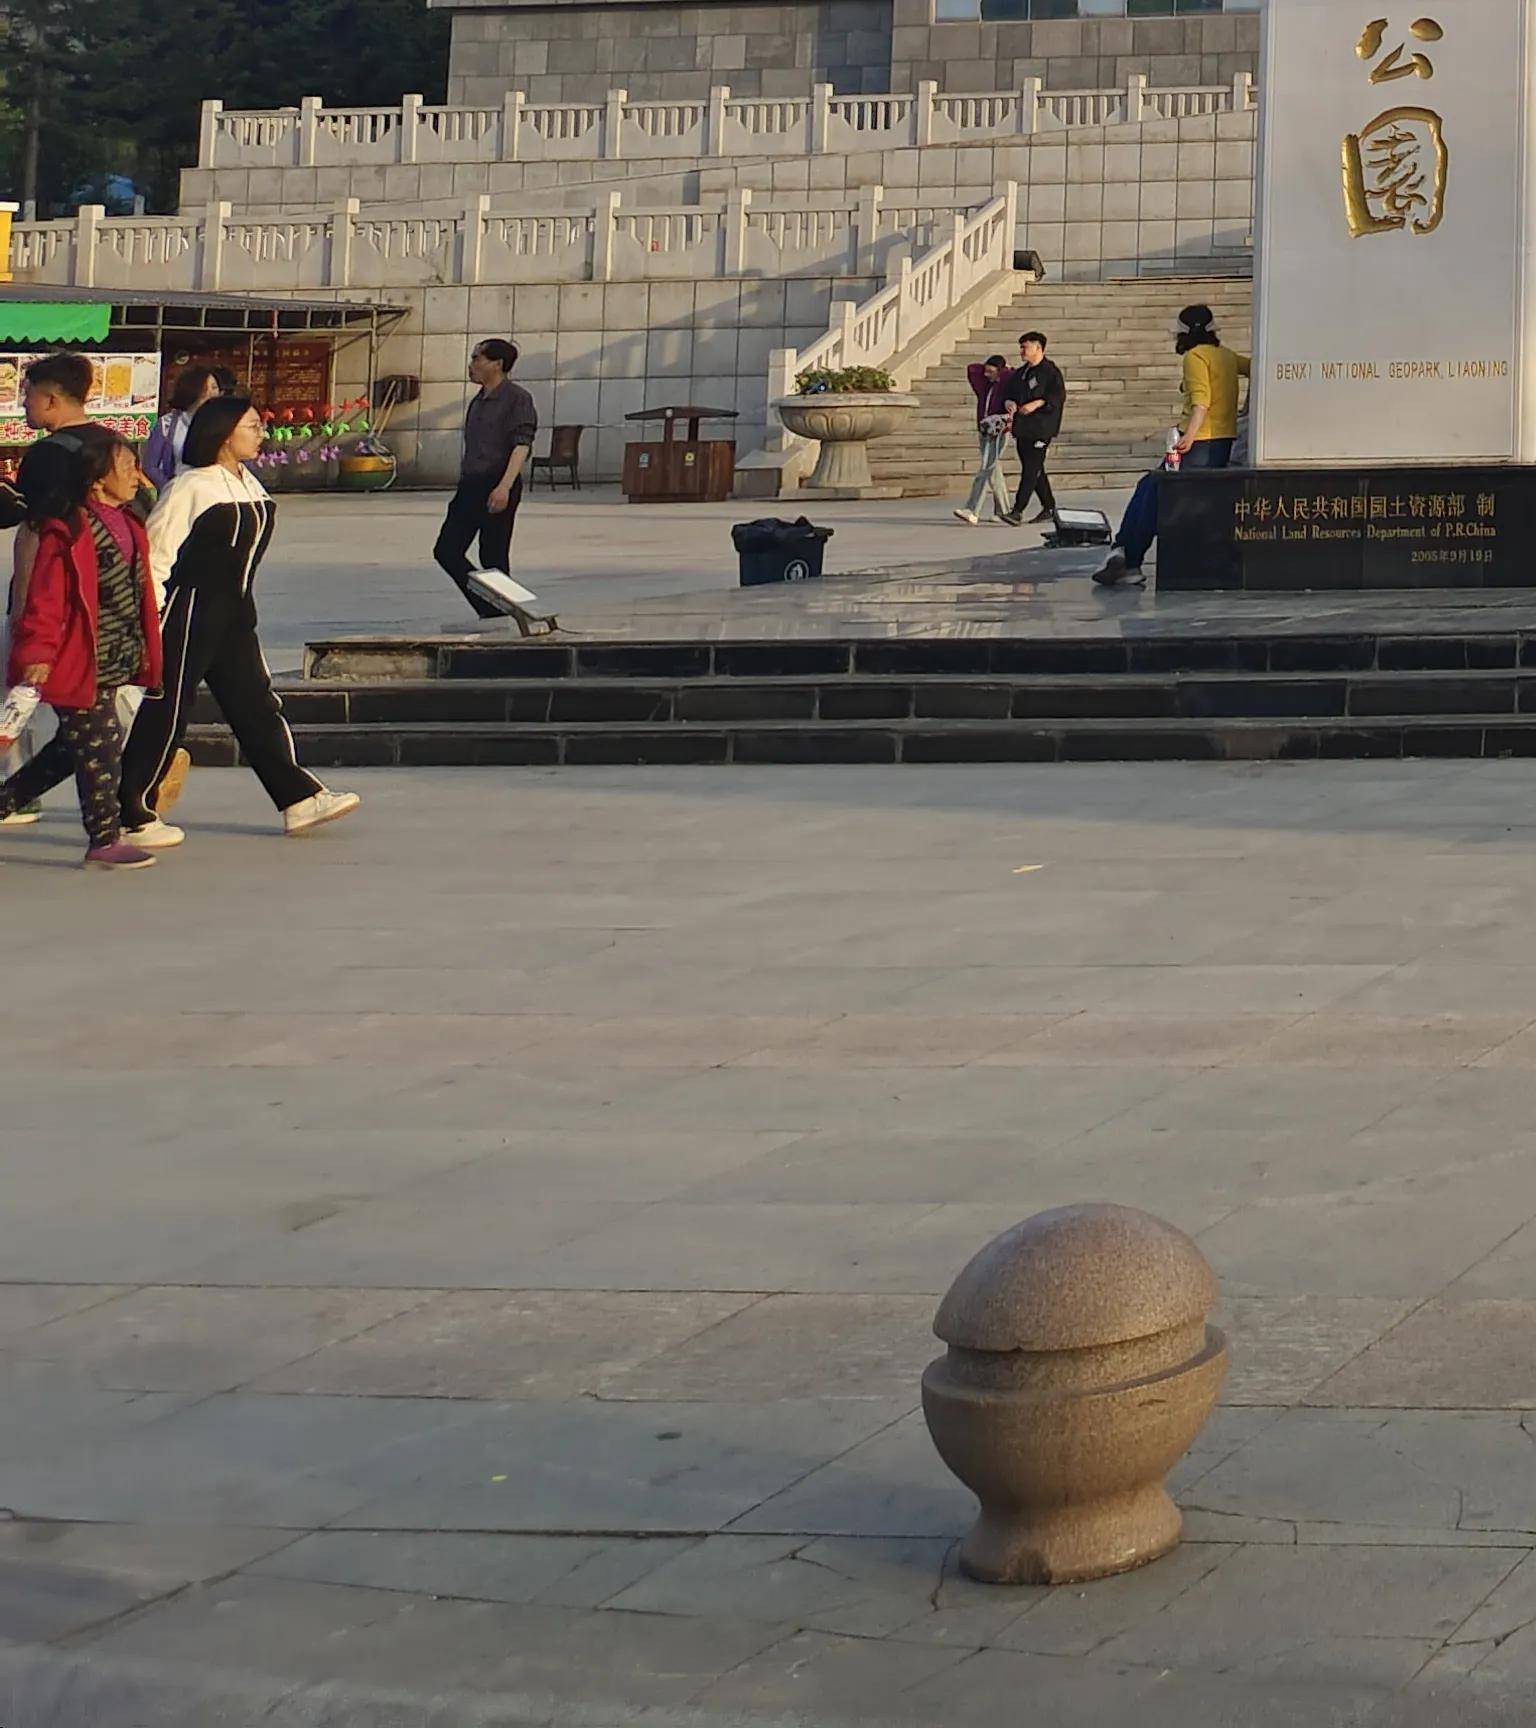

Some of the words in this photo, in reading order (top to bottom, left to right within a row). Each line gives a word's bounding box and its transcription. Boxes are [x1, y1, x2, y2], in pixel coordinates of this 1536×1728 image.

[1276, 363, 1312, 380] BENXI
[1321, 361, 1380, 380] NATIONAL
[1448, 360, 1509, 378] LIAONING
[1234, 491, 1466, 521] 中华人民共和国国土资源部
[1475, 491, 1496, 518] 制
[1234, 525, 1277, 541] National
[1282, 525, 1307, 540] Land
[1312, 525, 1362, 539] Resources
[1367, 524, 1426, 541] Department
[1430, 523, 1441, 537] of
